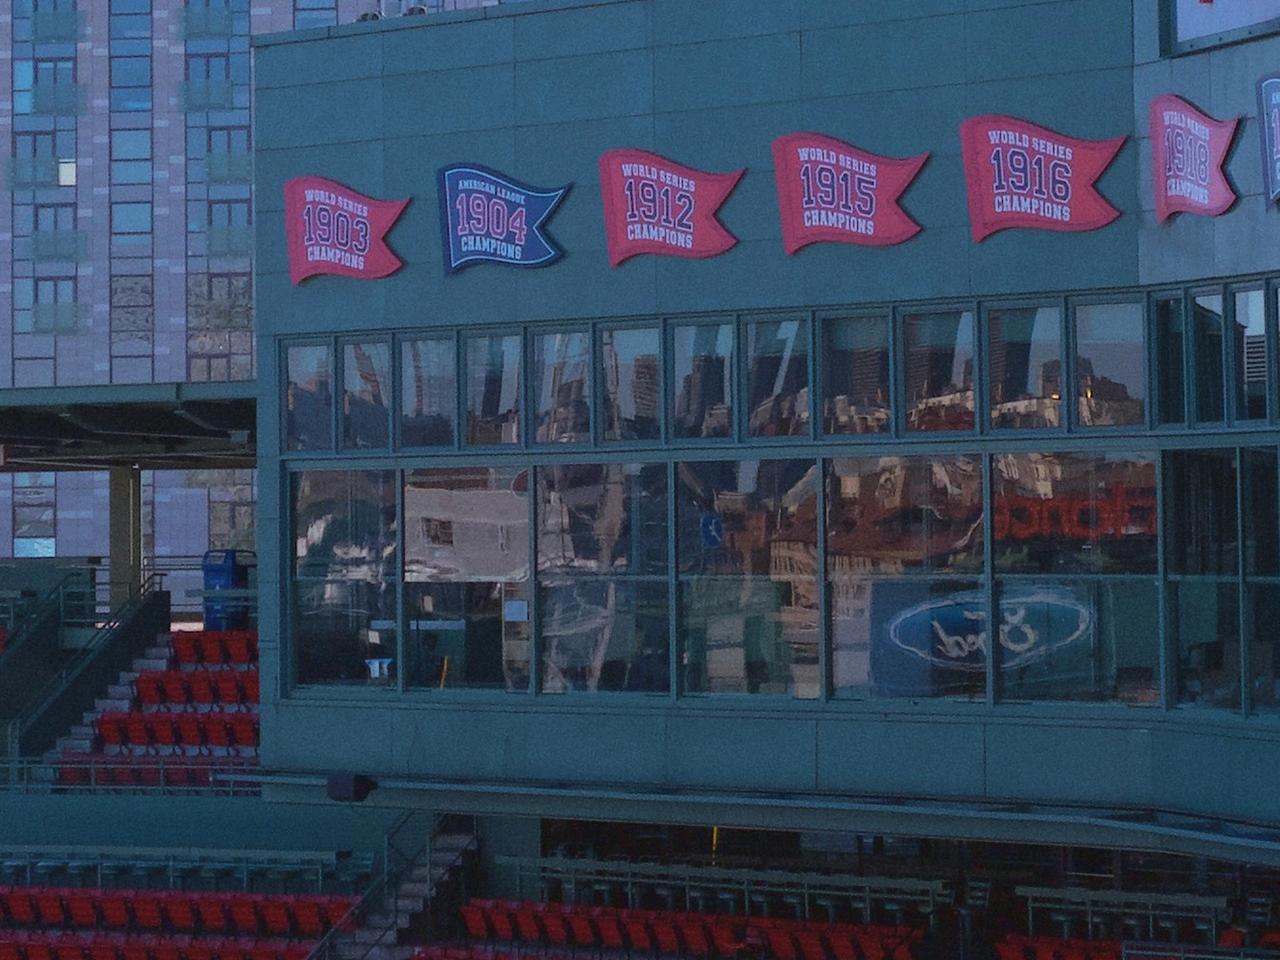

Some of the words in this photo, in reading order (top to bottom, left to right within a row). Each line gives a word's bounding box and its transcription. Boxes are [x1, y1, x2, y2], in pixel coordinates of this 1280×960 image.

[988, 130, 1029, 147] WORLD
[1032, 138, 1072, 160] SERIES
[1165, 128, 1209, 185] 1918
[798, 147, 836, 164] WORLD
[839, 154, 877, 176] SERIES
[991, 147, 1072, 204] 1916
[622, 163, 658, 179] WORLD
[660, 170, 695, 192] SERIES
[801, 163, 876, 218] 1915
[305, 189, 336, 205] WORLD
[337, 196, 368, 217] SERIES
[458, 180, 496, 195] AMERICAN
[496, 187, 526, 205] LEAGUE
[625, 179, 694, 232] 1912
[456, 193, 527, 245] 1904
[804, 210, 874, 235] CHAMPIONS
[995, 195, 1070, 222] CHAMPIONS
[304, 204, 370, 255] 1903
[627, 224, 693, 249] CHAMPIONS
[307, 246, 365, 270] CHAMPIONS
[461, 235, 522, 259] CHAMPIONS
